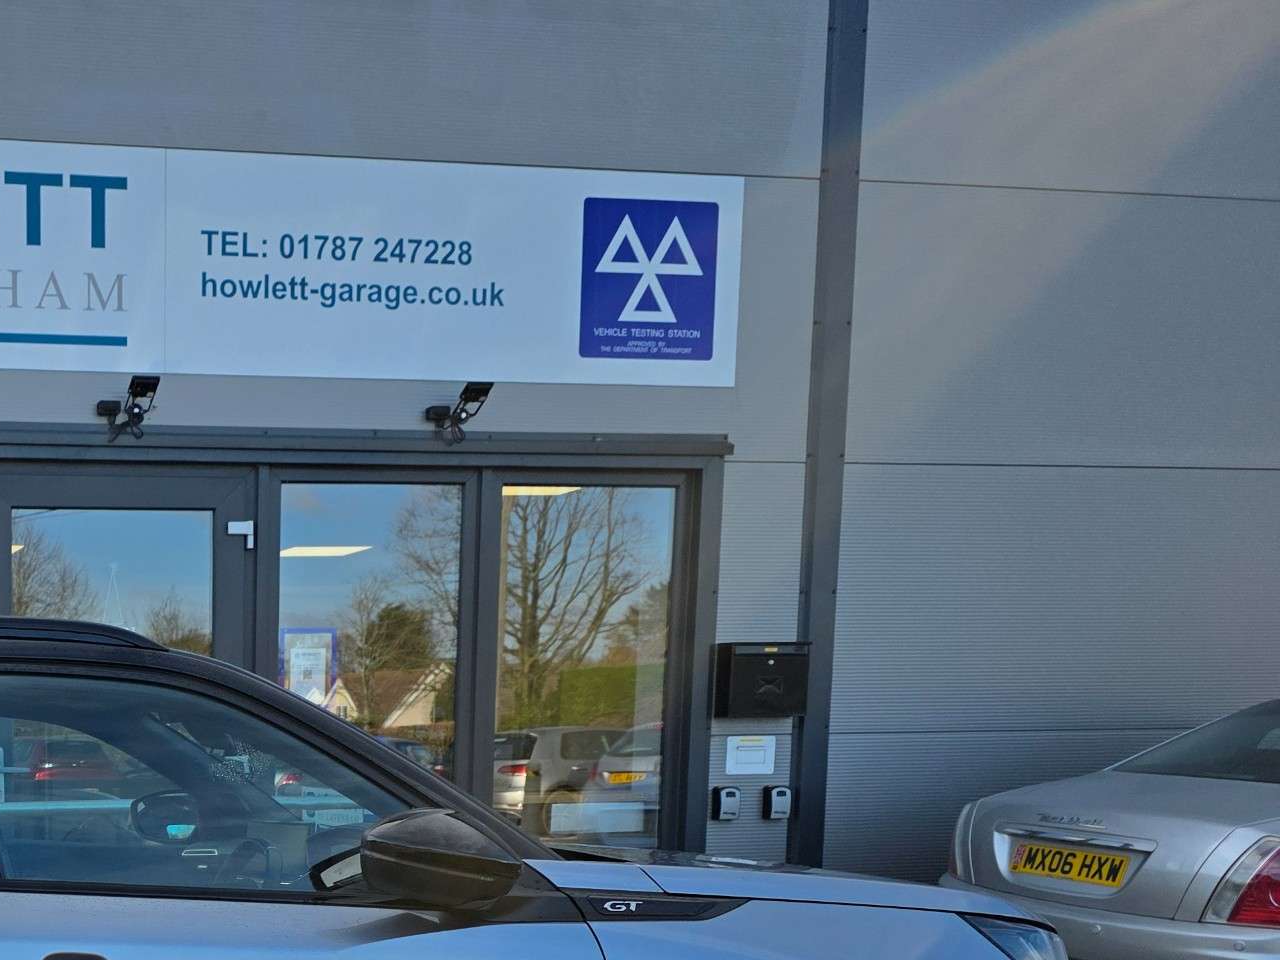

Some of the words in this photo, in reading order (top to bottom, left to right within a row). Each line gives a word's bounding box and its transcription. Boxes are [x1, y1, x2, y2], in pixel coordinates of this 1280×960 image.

[200, 229, 268, 258] TEL:
[279, 233, 364, 261] 01787
[373, 237, 473, 266] 247228
[200, 271, 505, 310] howlett-garage.co.uk
[593, 327, 628, 337] VEHICLE
[631, 328, 665, 338] TESTING
[667, 329, 701, 339] STATION
[1022, 846, 1077, 875] MX06
[1076, 854, 1124, 882] HXW
[603, 900, 643, 912] GT
